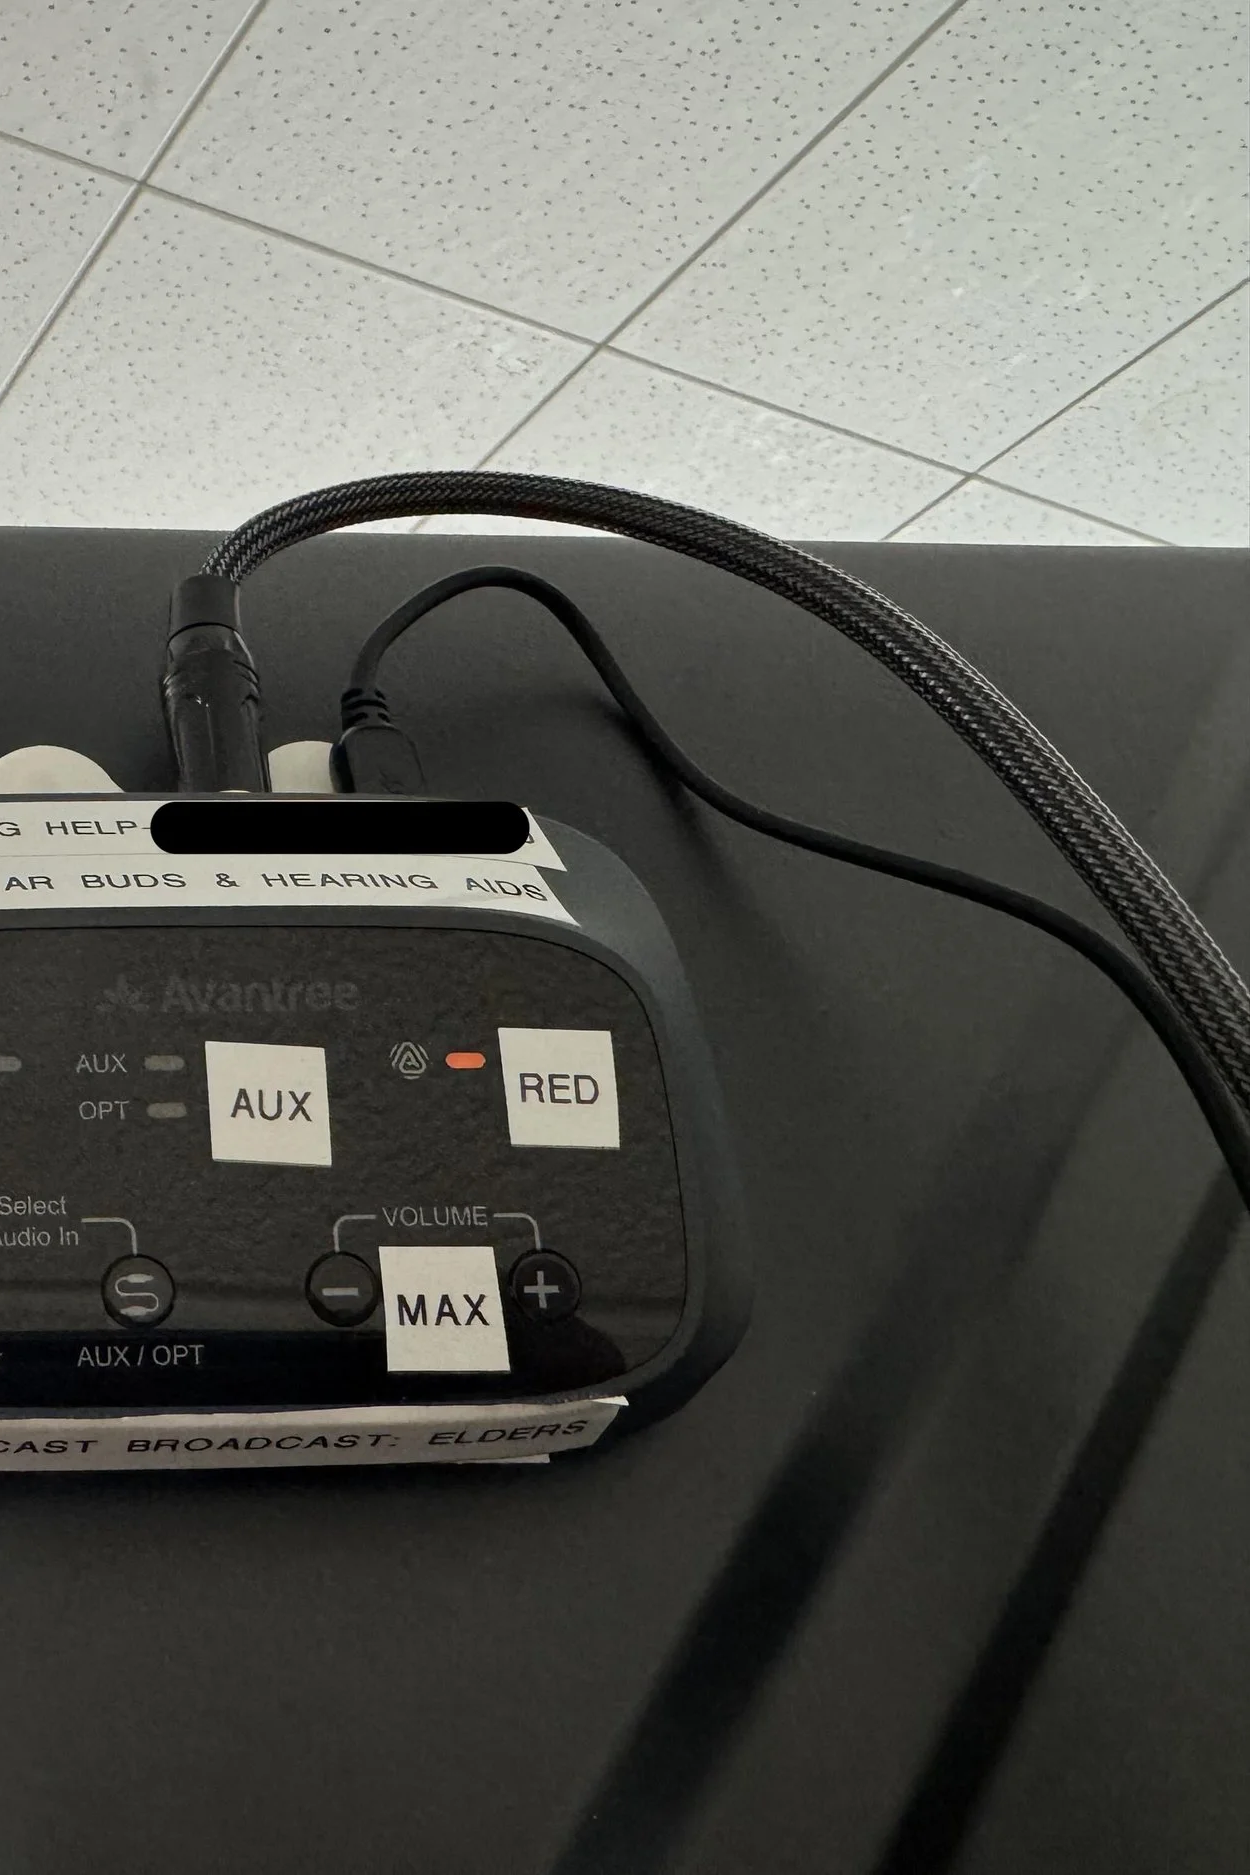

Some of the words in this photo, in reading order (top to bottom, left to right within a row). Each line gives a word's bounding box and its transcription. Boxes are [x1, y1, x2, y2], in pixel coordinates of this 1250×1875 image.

[80, 873, 187, 890] BUDS
[215, 872, 240, 889] &
[260, 873, 440, 890] HEARING
[465, 876, 549, 902] AIDS
[161, 973, 361, 1013] Avantree
[75, 1053, 128, 1074] AUX
[518, 1072, 600, 1106] RED
[78, 1100, 130, 1121] OPT
[230, 1087, 314, 1123] AUX
[381, 1205, 489, 1227] VOLUME
[58, 1226, 80, 1246] In
[396, 1293, 491, 1327] MAX
[76, 1346, 131, 1368] AUX
[151, 1344, 205, 1367] OPT
[126, 1433, 401, 1454] BROADCAST:
[427, 1419, 589, 1446] ELDERS
